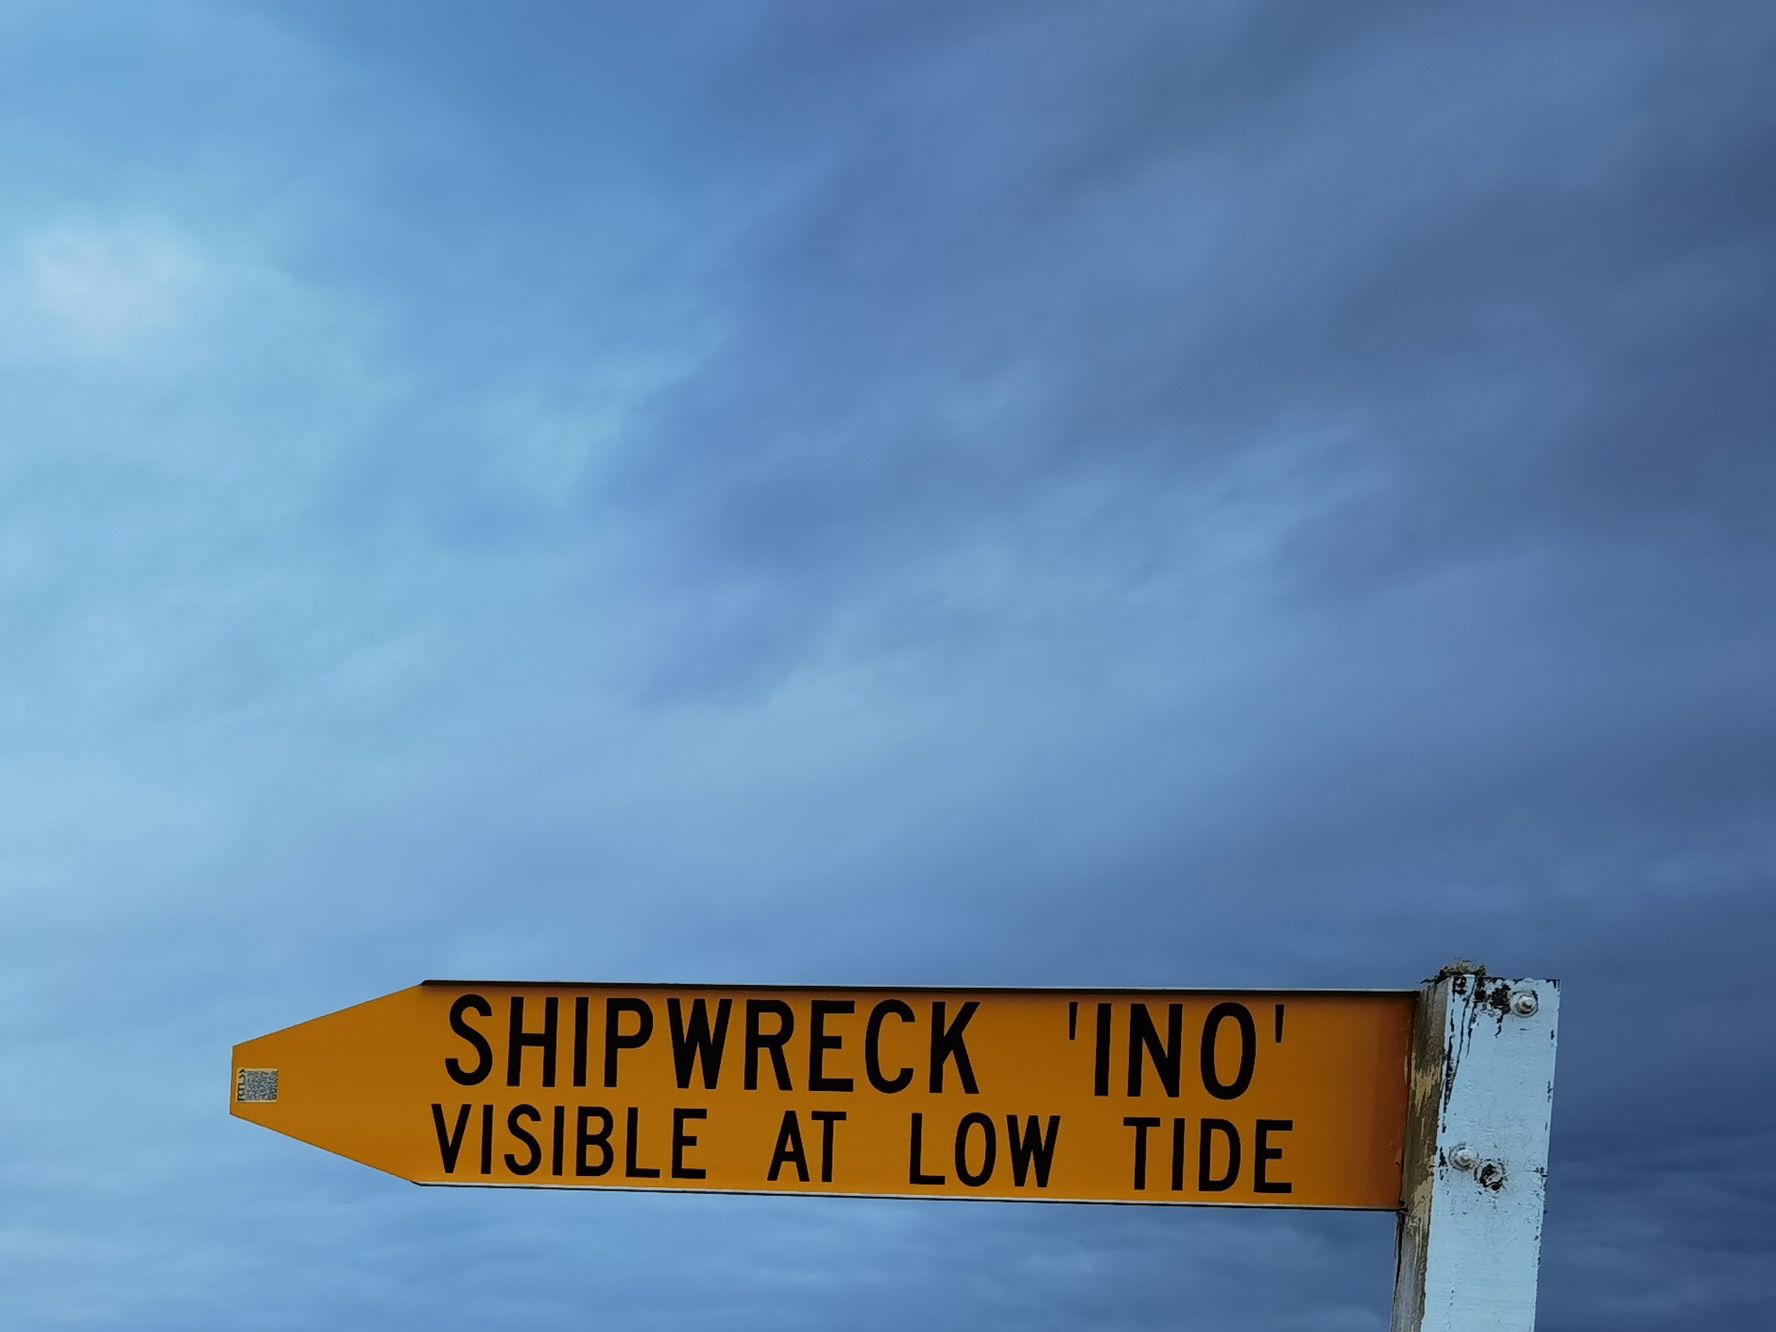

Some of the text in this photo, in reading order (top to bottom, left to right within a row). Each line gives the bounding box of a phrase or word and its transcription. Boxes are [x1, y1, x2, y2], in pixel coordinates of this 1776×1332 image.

[444, 994, 1286, 1101] SHIPWRECK 'INO'
[431, 1103, 1293, 1194] VISIBLE AT LOW TIDE
